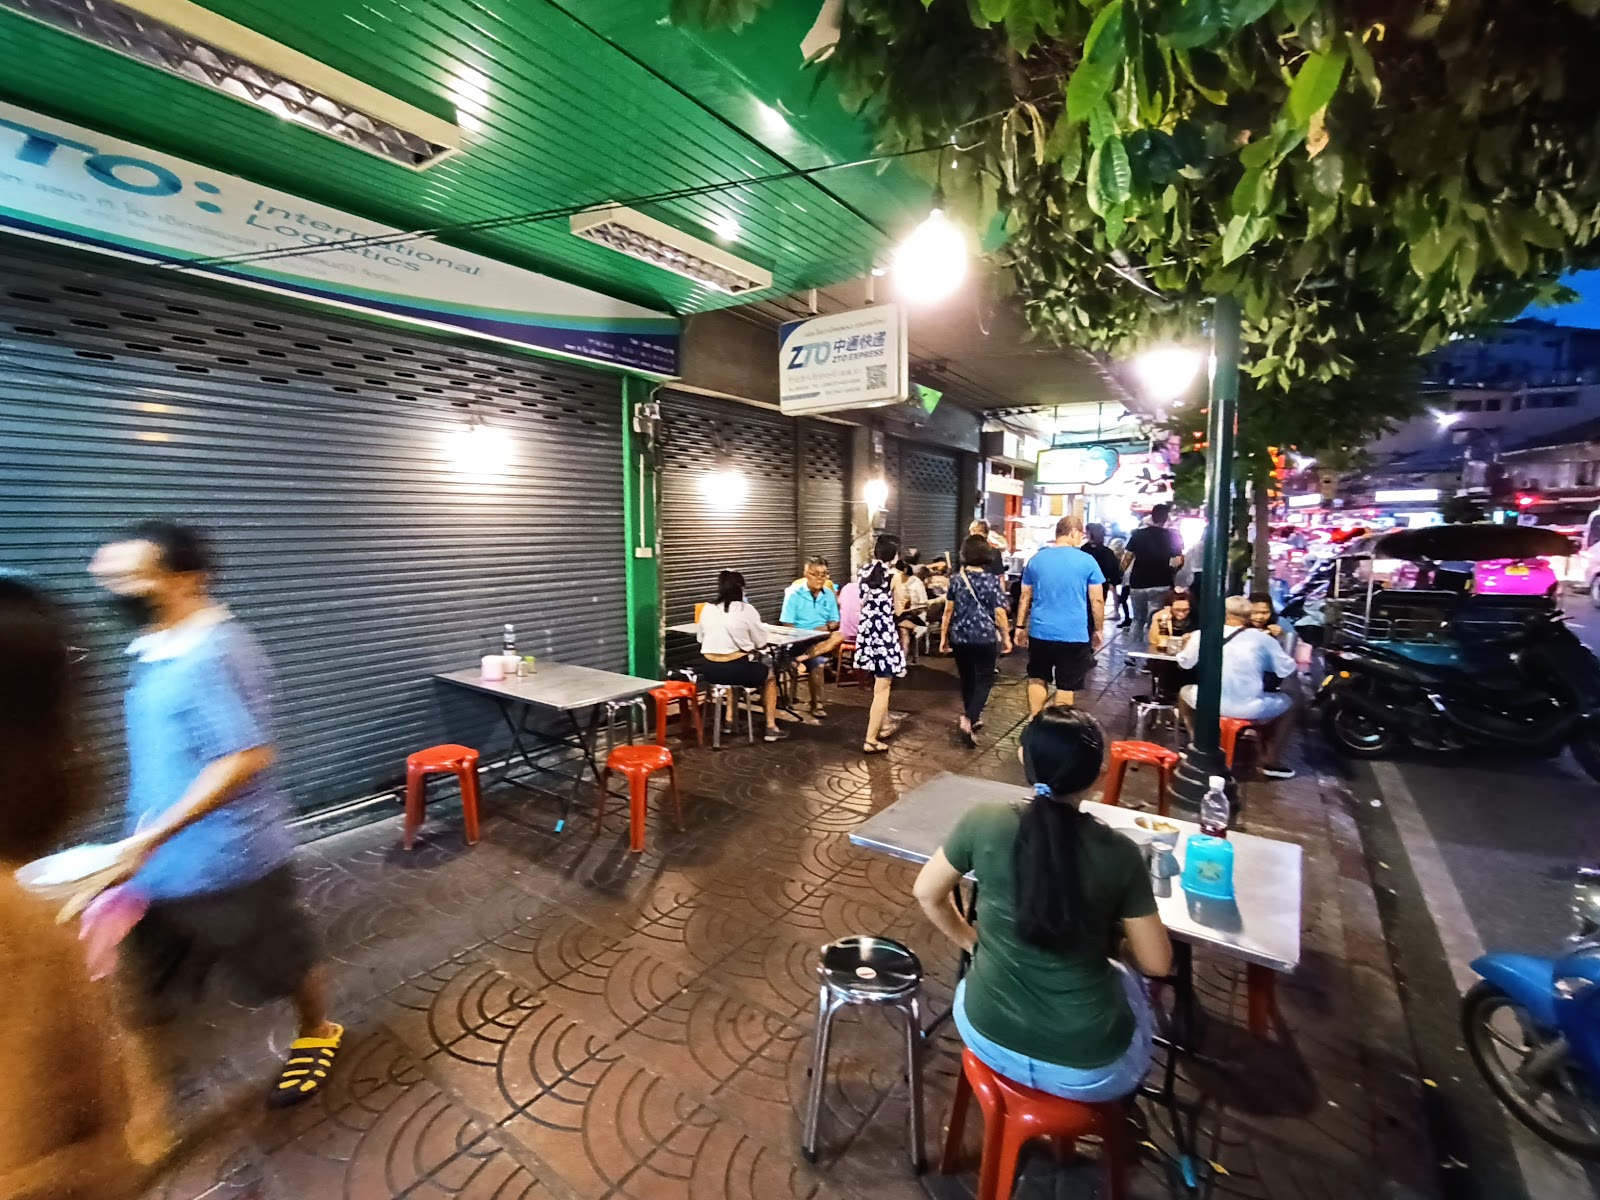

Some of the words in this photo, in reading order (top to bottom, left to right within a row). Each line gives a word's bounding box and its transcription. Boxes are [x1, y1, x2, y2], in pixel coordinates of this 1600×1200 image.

[245, 214, 421, 272] Logistics
[250, 199, 481, 276] International
[787, 341, 832, 370] ZTO
[832, 354, 848, 364] ZTO
[848, 349, 884, 361] EXPRESS
